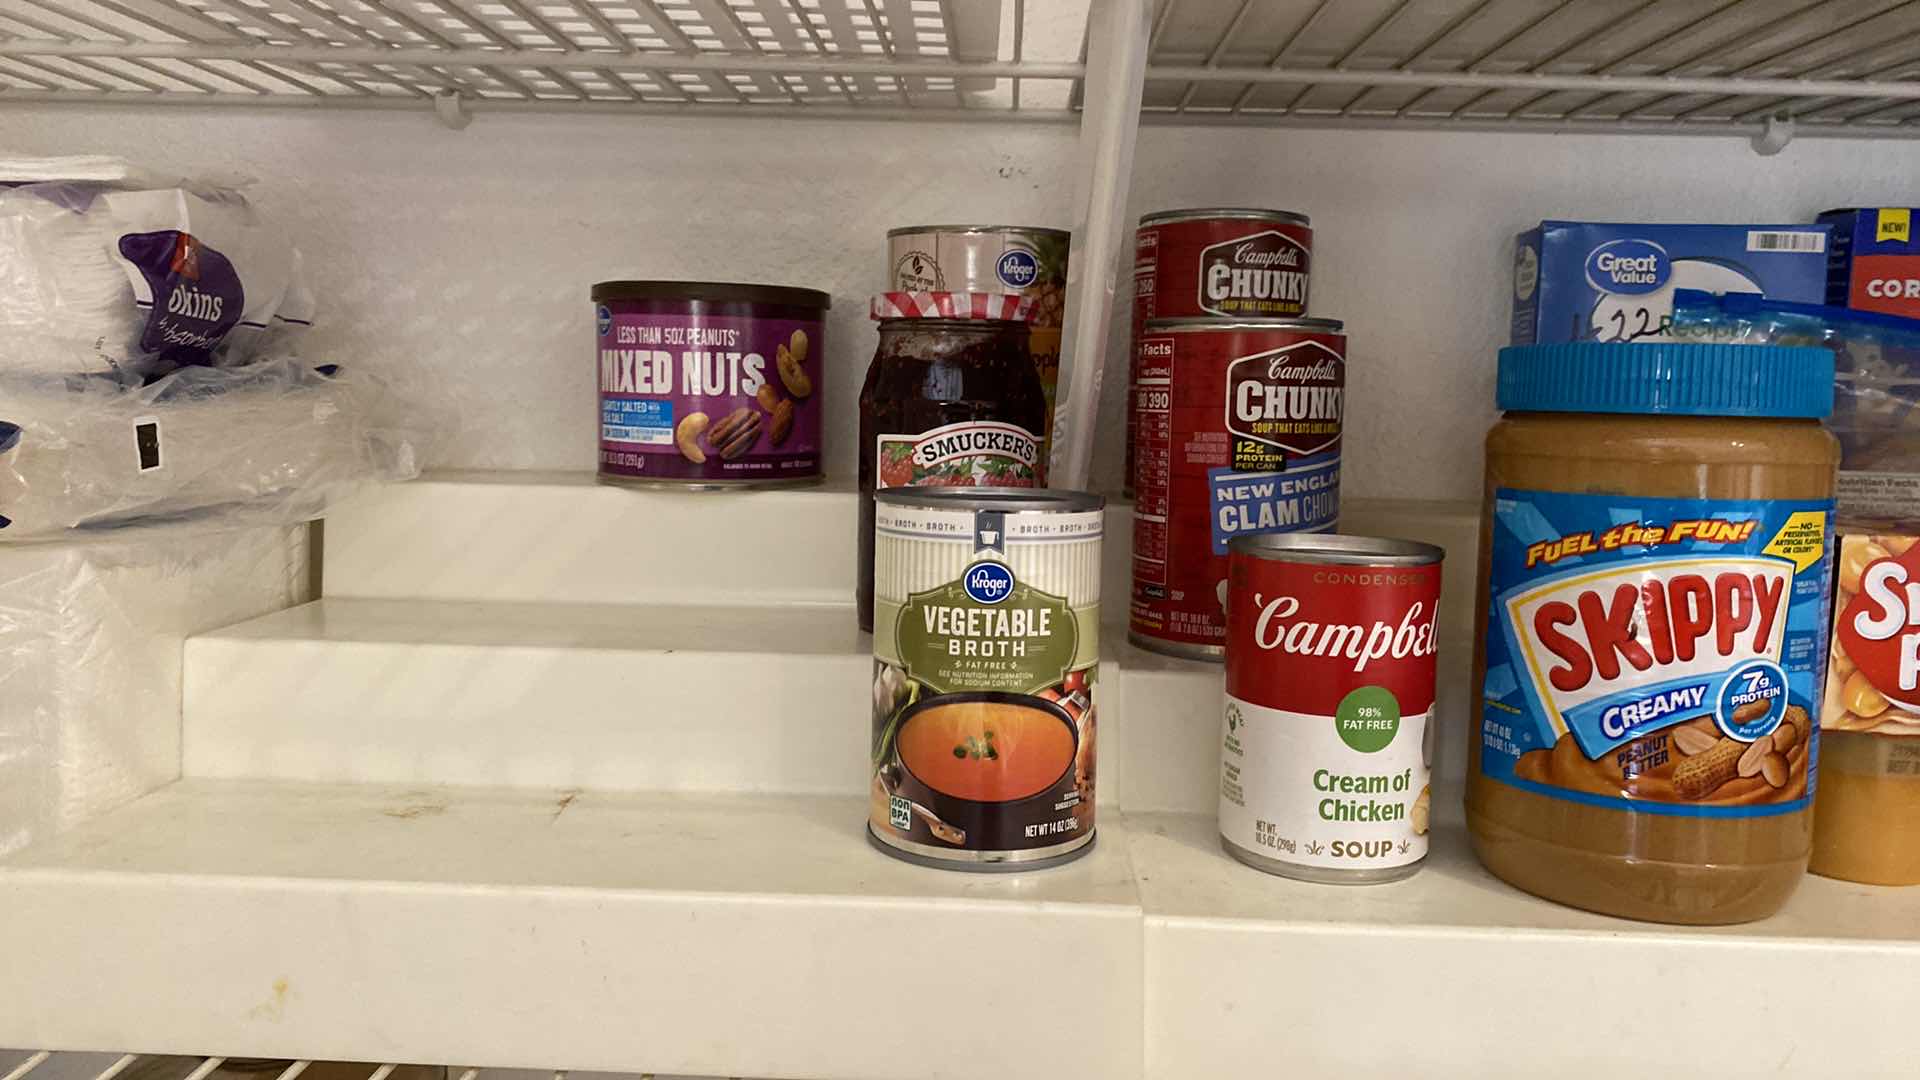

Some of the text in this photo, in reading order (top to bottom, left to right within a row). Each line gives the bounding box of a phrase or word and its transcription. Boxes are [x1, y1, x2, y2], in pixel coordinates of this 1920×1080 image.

[1881, 223, 1907, 233] NEW!
[1003, 257, 1033, 281] Kroger
[1597, 252, 1657, 273] Great
[1207, 263, 1308, 304] CHUNKY
[1611, 269, 1657, 285] Value
[617, 325, 636, 344] LESS
[638, 327, 661, 345] THAN
[1144, 344, 1171, 356] Facts
[601, 350, 766, 397] MIXED NUTS
[1149, 392, 1168, 409] 390
[1252, 422, 1273, 434] SOUP
[1275, 422, 1293, 434] THAT
[1294, 423, 1310, 434] EATS
[921, 431, 1034, 462] SMUCKER'S
[1236, 441, 1264, 454] 12g
[1235, 454, 1282, 463] PROTEIN
[1256, 462, 1276, 471] CAN
[1217, 484, 1275, 502] NEW
[1218, 498, 1298, 532] CLAM
[894, 517, 917, 529] BROTH
[926, 522, 956, 531] BROTH
[1020, 525, 1050, 534] BROTH
[1060, 524, 1082, 533] BROTH
[1800, 522, 1812, 530] NO
[1526, 519, 1758, 568] FUEL the FUN!
[971, 569, 1008, 597] Kroger
[923, 605, 1051, 637] VEGETABLE
[1534, 572, 1784, 692] SKIPPY
[949, 639, 1025, 657] BROTH
[966, 661, 1006, 670] FAT FREE
[1742, 670, 1769, 693] 7g
[1731, 686, 1781, 706] PROTEIN
[1358, 706, 1382, 719] 98%
[1600, 685, 1707, 738] CREAMY
[1343, 719, 1394, 731] FAT FREE
[1617, 735, 1667, 768] PEANUT
[1313, 767, 1411, 793] Cream of
[892, 797, 910, 811] non
[1318, 799, 1405, 823] Chicken
[892, 807, 909, 822] BPA
[1025, 824, 1037, 838] NET
[1038, 823, 1048, 836] WT
[1049, 821, 1057, 834] 14
[1057, 819, 1065, 833] OZ
[1256, 819, 1278, 836] NET WT.
[1330, 840, 1394, 858] SOUP
